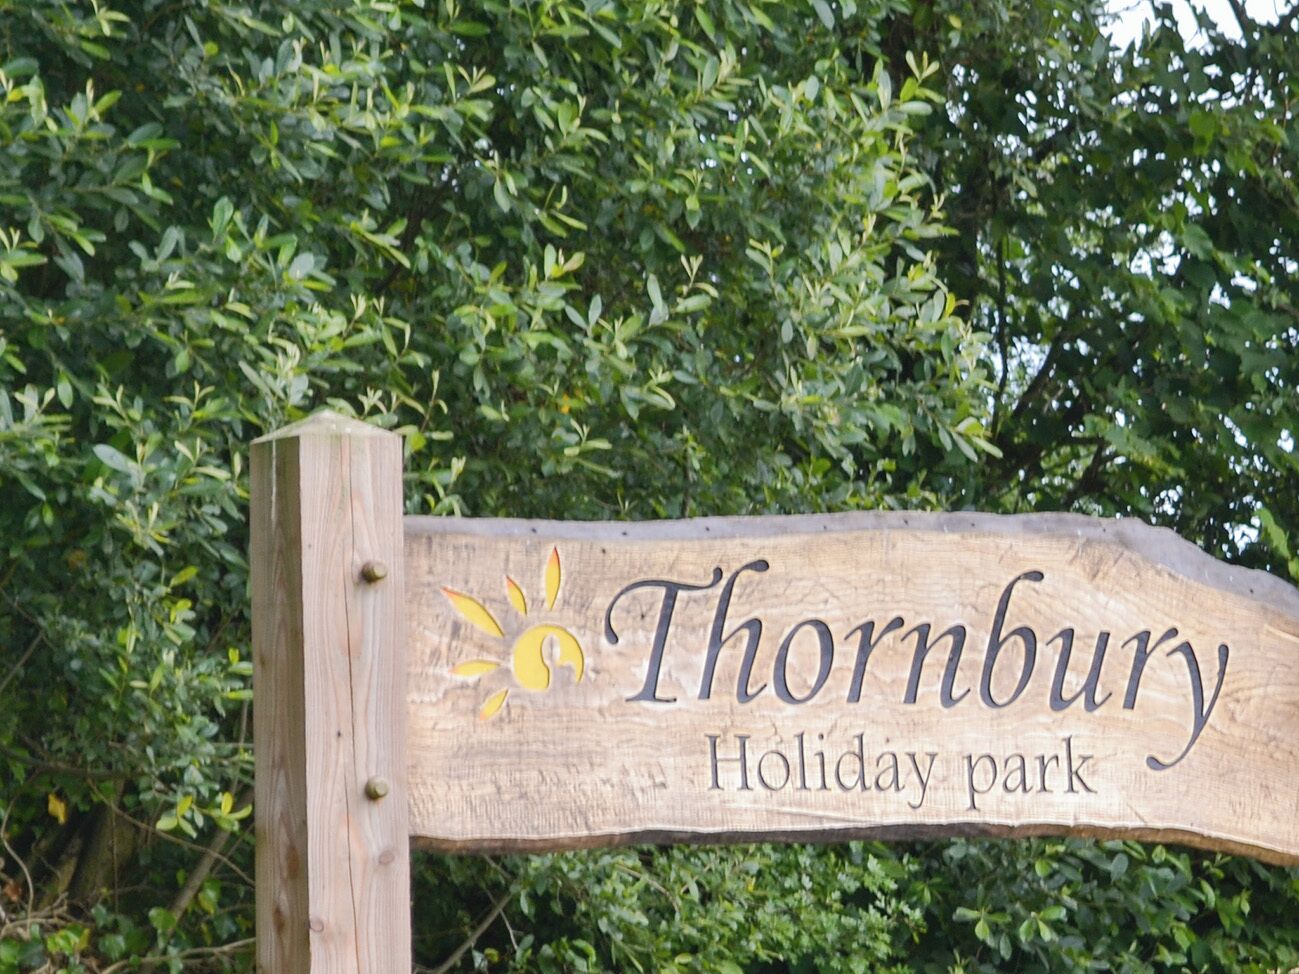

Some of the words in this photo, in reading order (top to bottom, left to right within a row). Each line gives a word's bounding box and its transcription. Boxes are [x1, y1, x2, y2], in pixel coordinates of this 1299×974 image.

[604, 558, 1230, 772] Thornbury
[706, 731, 938, 810] Holiday
[965, 737, 1097, 811] park
